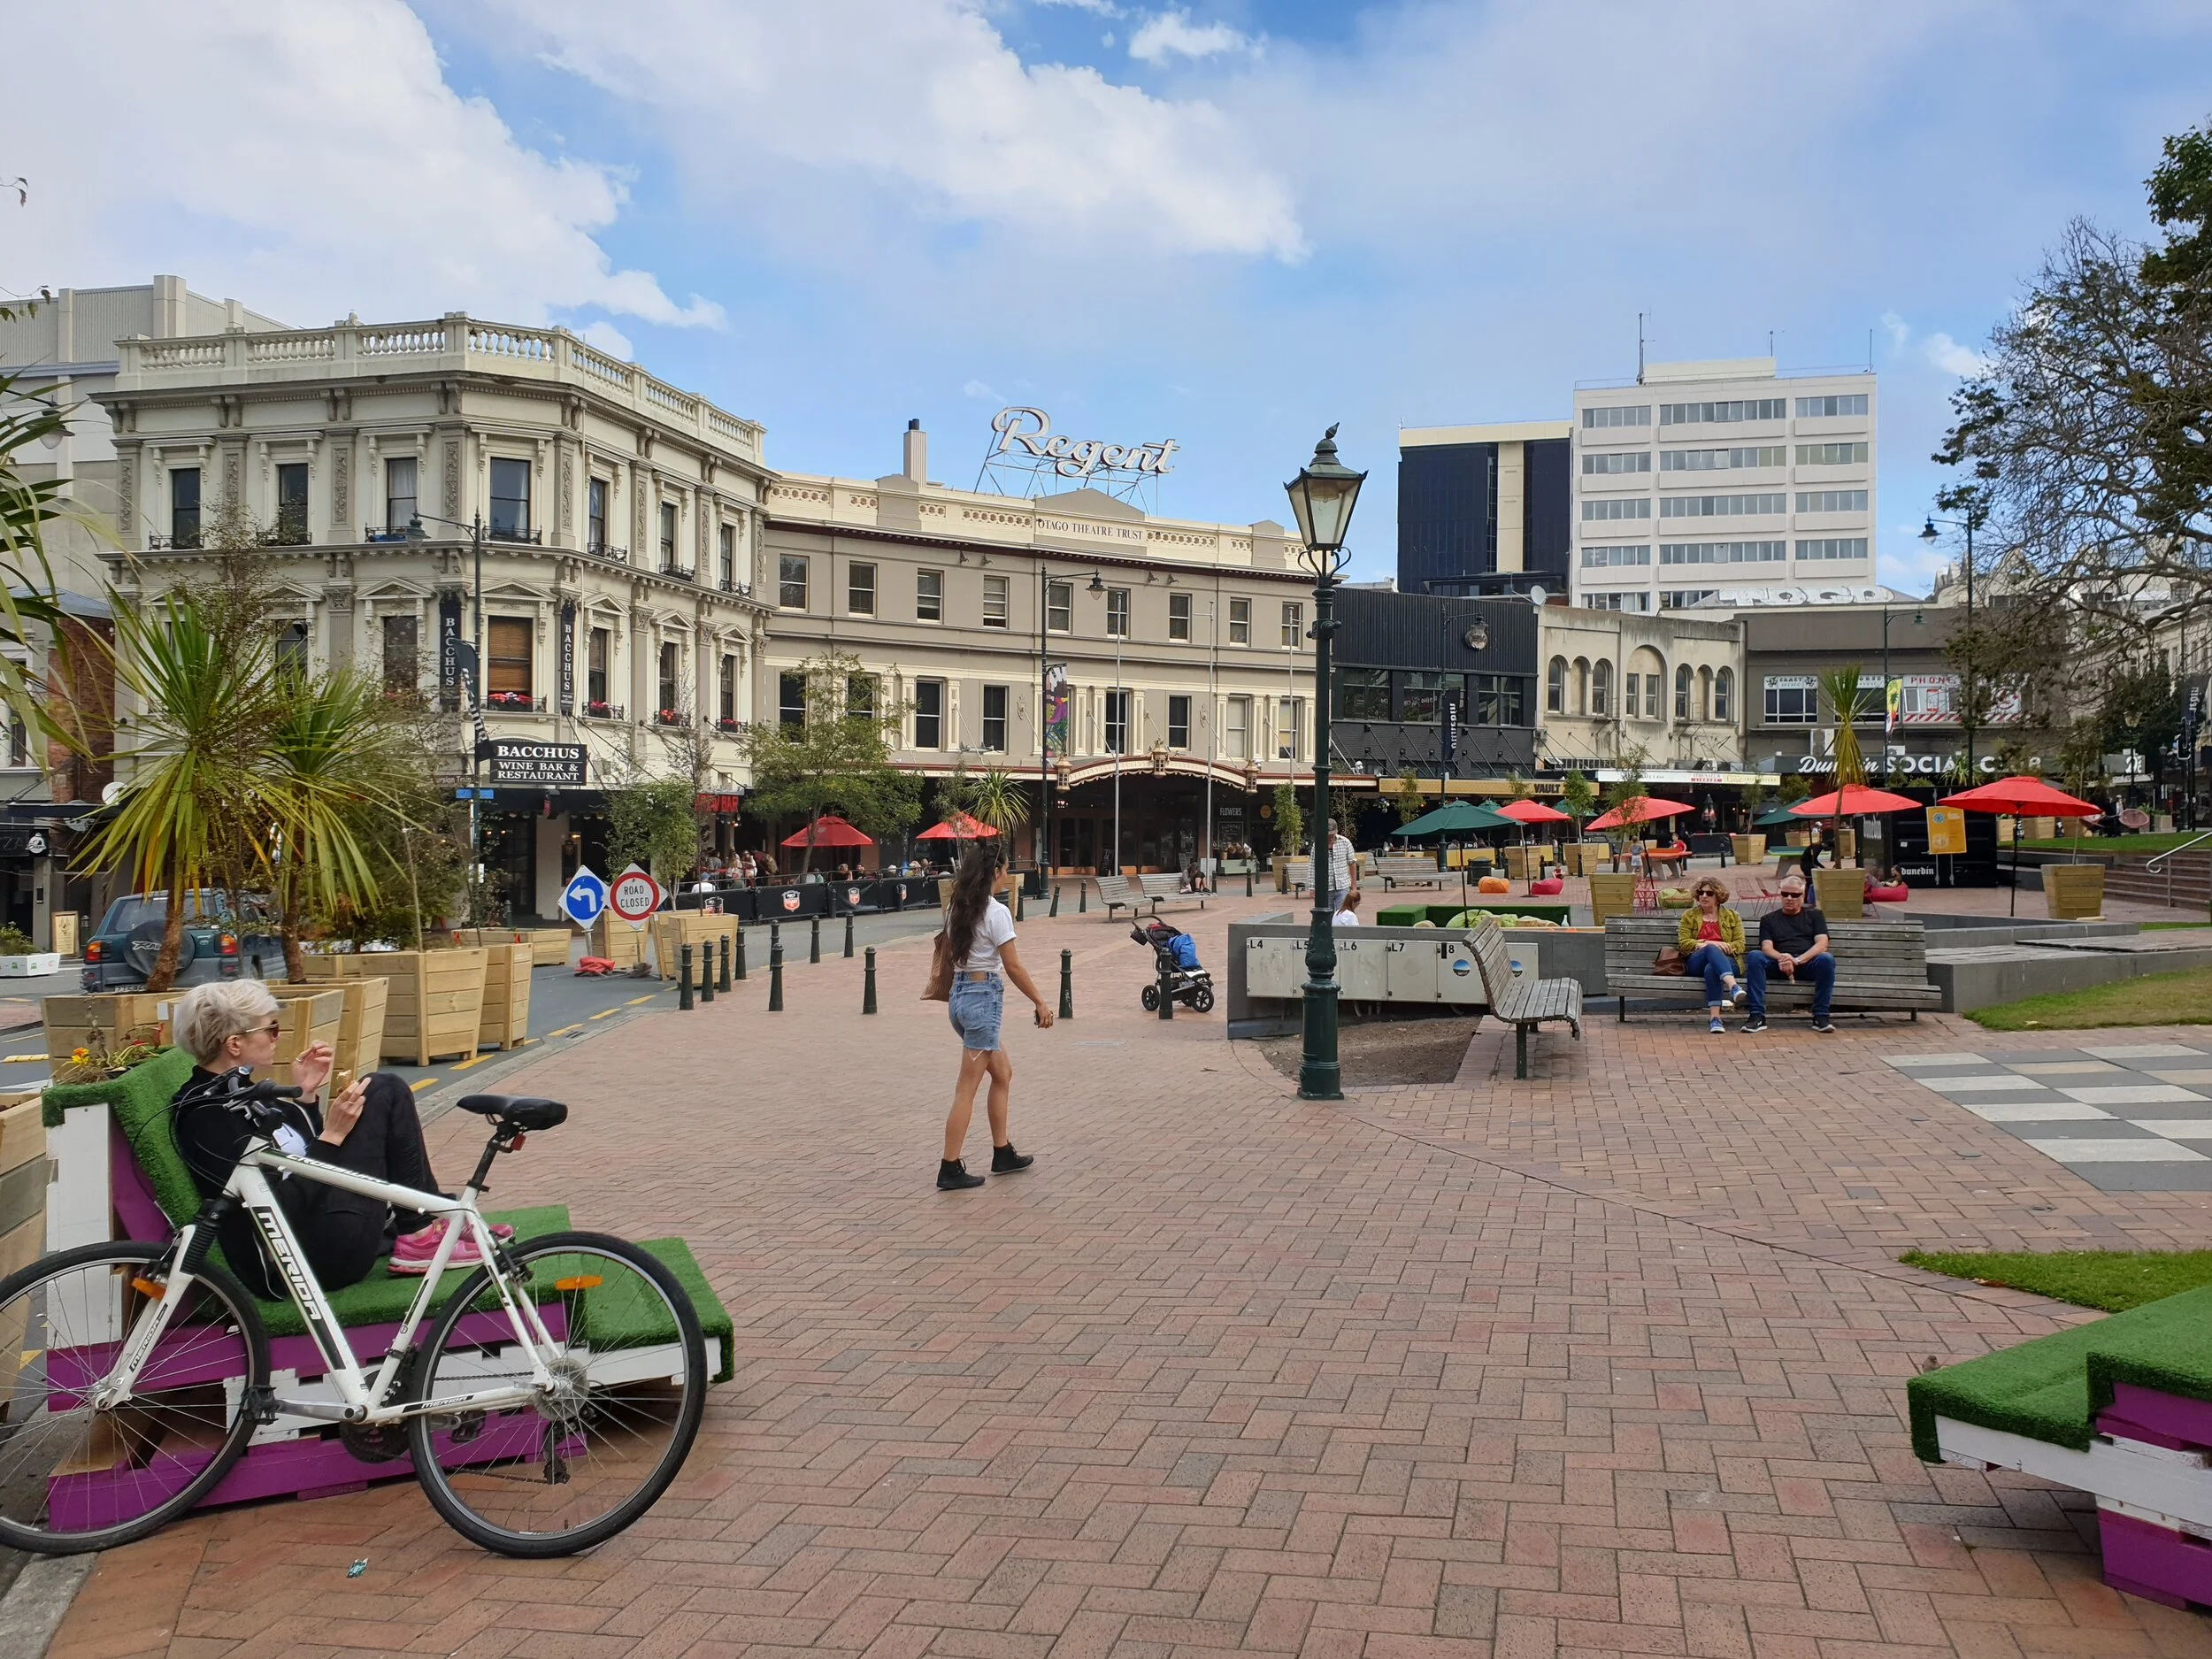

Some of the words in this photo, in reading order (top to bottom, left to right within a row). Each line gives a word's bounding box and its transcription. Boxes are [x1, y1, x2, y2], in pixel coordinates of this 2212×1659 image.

[991, 406, 1180, 478] Regent
[1038, 518, 1069, 532] OTAGO
[1071, 523, 1114, 536] THEATRE
[1116, 528, 1143, 540] TRUST
[445, 618, 456, 687] BACCHUS
[564, 624, 572, 691] BACCHUS
[496, 745, 580, 759] BACCHUS
[499, 762, 534, 771] WINE
[496, 771, 580, 781] RESTAURANT
[1533, 783, 1561, 794] VAULT
[722, 795, 739, 812] BAR
[1219, 807, 1242, 817] FLOWERS
[1901, 866, 1934, 875] dunedin
[624, 885, 644, 895] ROAD
[620, 897, 649, 909] CLOSED
[1250, 940, 1263, 949] L4
[1343, 941, 1357, 951] L6
[1391, 942, 1405, 951] L7
[257, 1212, 322, 1320] MERIDA
[421, 1395, 468, 1409] MERIDA
